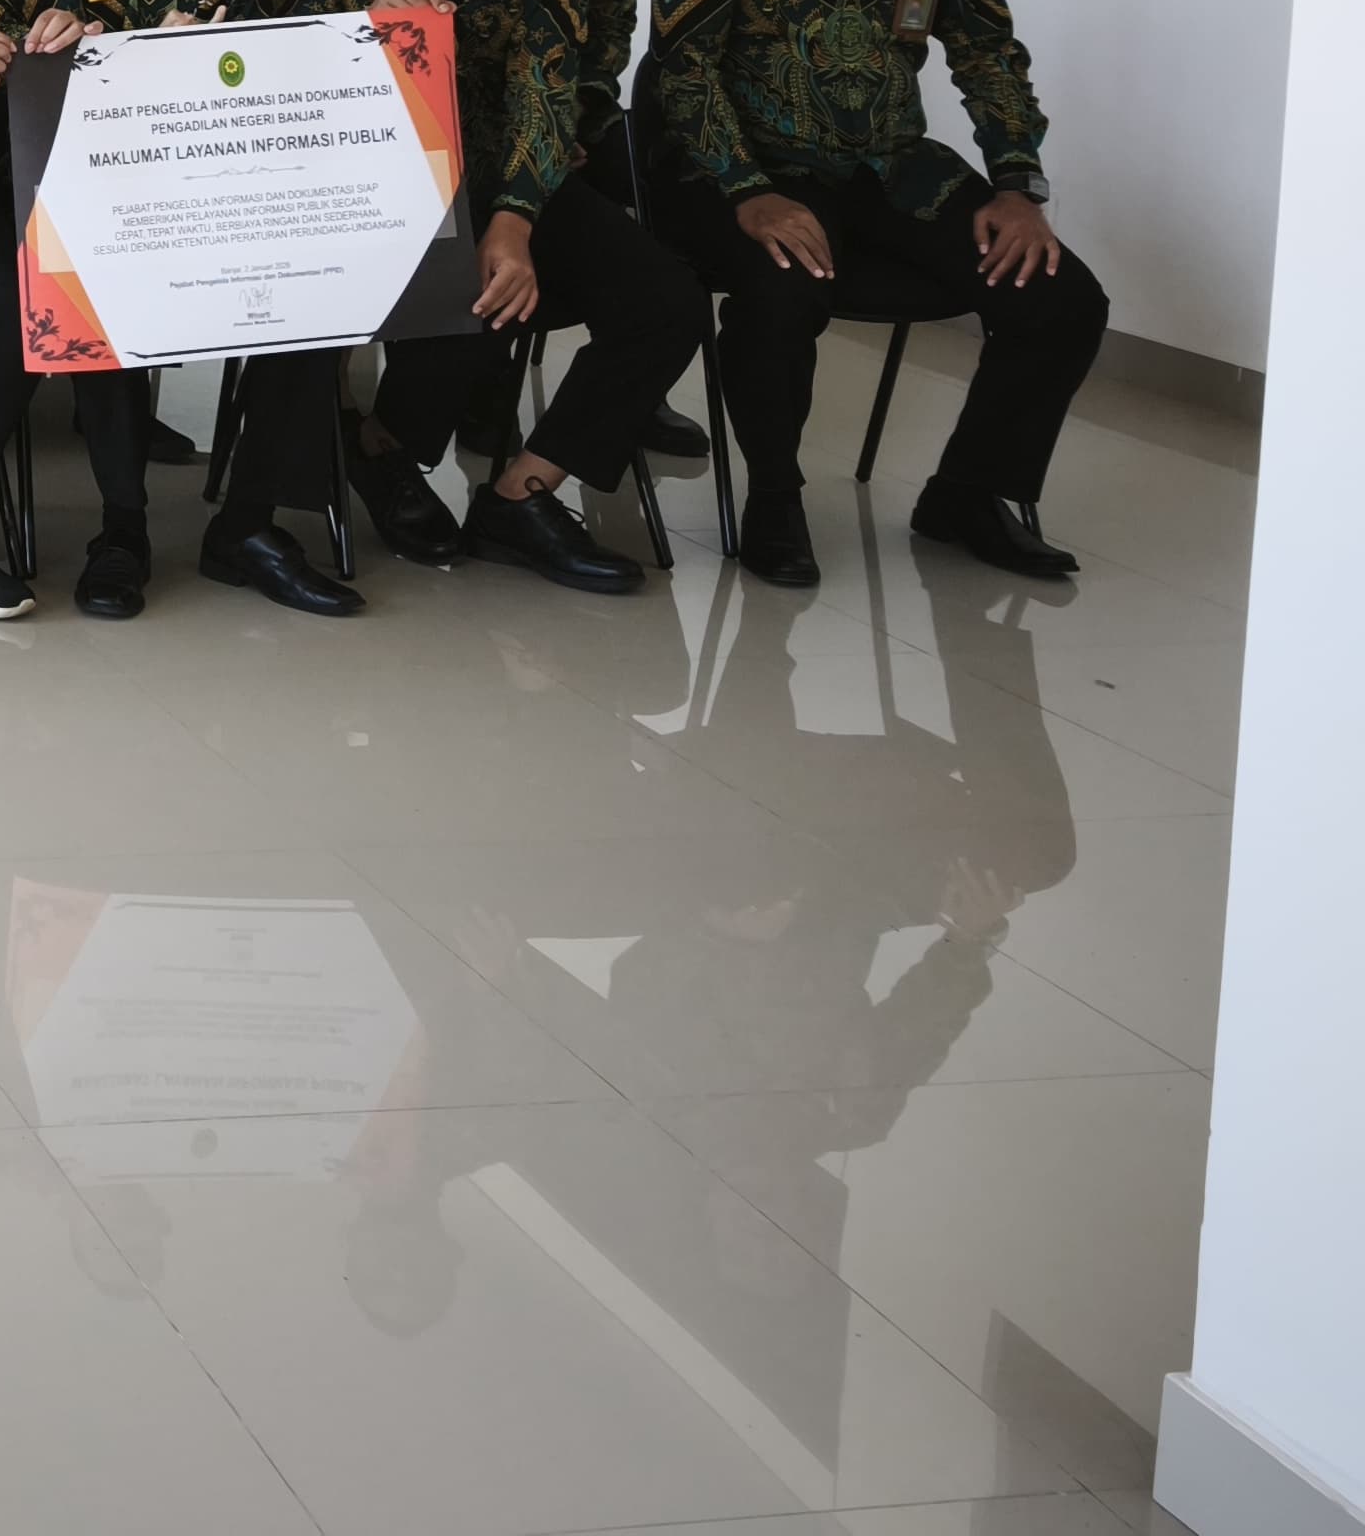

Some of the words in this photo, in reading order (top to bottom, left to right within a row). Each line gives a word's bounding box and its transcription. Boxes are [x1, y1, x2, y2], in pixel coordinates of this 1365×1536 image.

[83, 106, 132, 121] PEJABAT
[136, 100, 207, 117] PENGELOLA
[210, 94, 275, 111] INFORMASI
[277, 92, 302, 105] DAN
[305, 85, 392, 103] DOKUMENTASI
[150, 118, 227, 135] PENGADILAN
[230, 114, 275, 128] NEGERI
[277, 110, 324, 124] BANJAR
[88, 147, 169, 168] MAKLUMAT
[175, 140, 246, 160] LAYANAN
[251, 133, 334, 154] INFORMASI
[338, 127, 395, 146] PUBLIK
